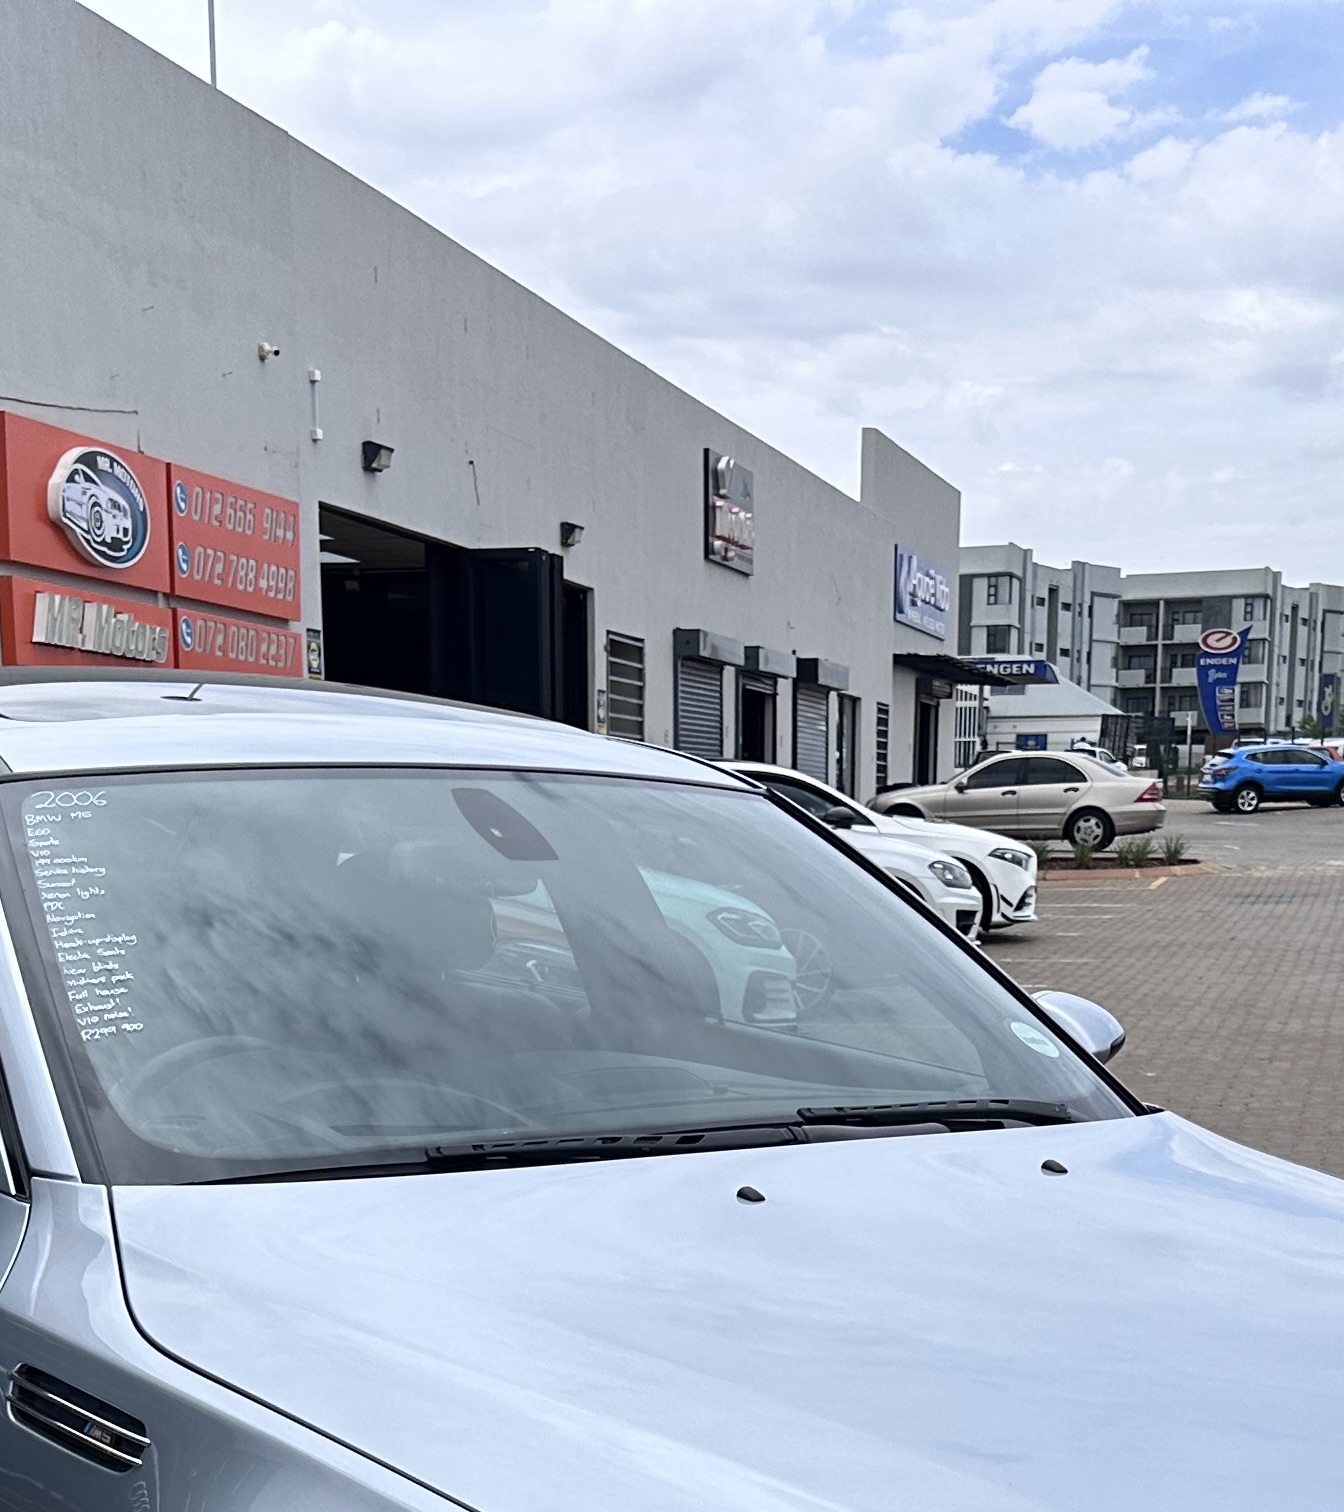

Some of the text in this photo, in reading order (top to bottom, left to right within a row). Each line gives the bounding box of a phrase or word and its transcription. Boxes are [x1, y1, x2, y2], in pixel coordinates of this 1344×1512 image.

[192, 485, 296, 548] 012 666 9144
[193, 545, 296, 602] 072 788 4998
[83, 602, 169, 664] Motors
[195, 618, 296, 668] 072 080 2237
[25, 814, 62, 826] BMW
[31, 790, 107, 809] 2006
[43, 901, 65, 911] PDC
